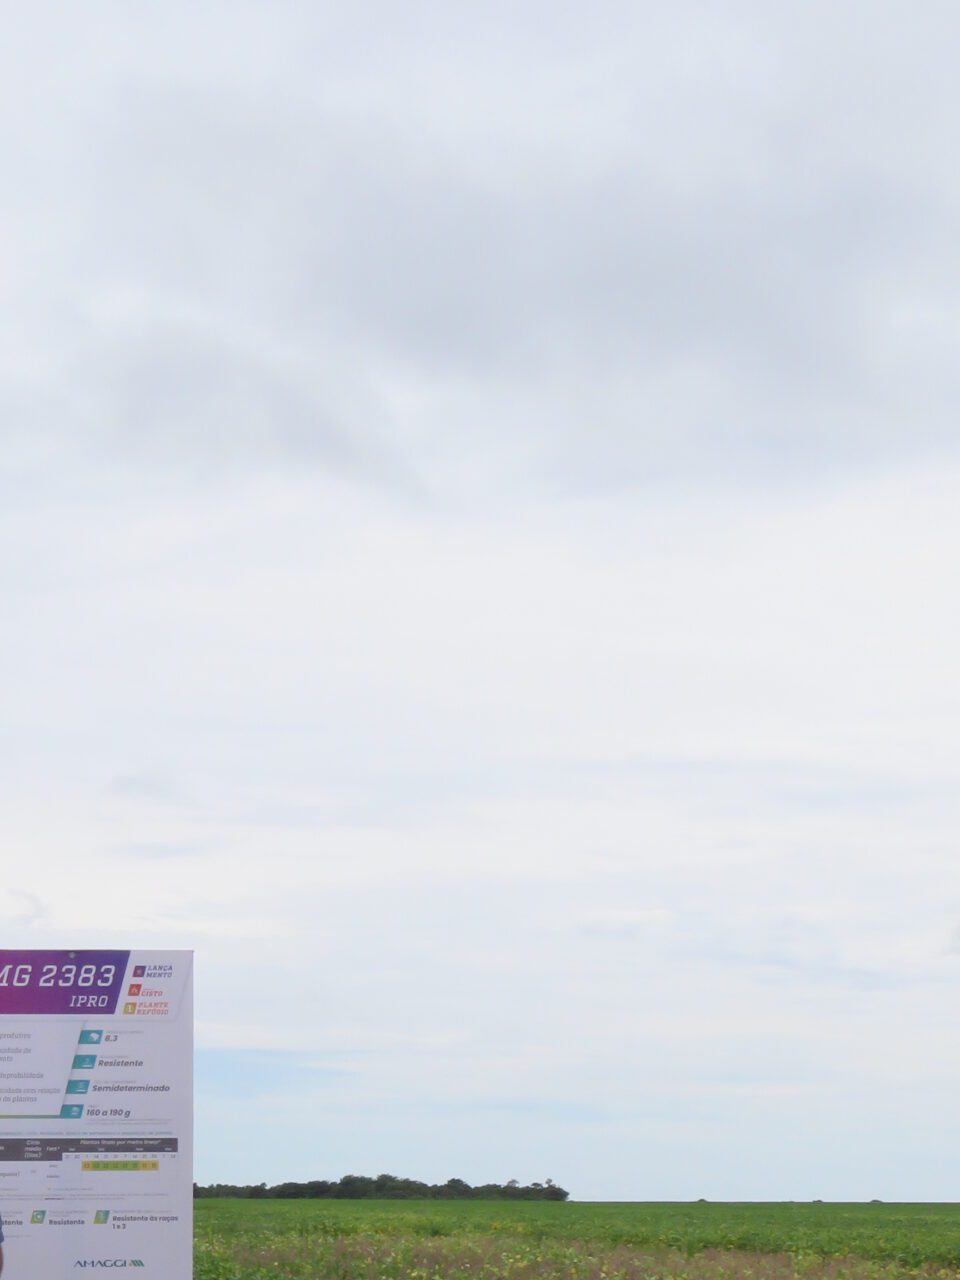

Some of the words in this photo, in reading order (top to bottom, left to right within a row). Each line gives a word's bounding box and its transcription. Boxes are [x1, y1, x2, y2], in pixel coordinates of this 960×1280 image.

[39, 964, 116, 987] 2383
[69, 995, 108, 1008] IPRO
[124, 1110, 131, 1118] g
[73, 1259, 127, 1268] AMAGGI
